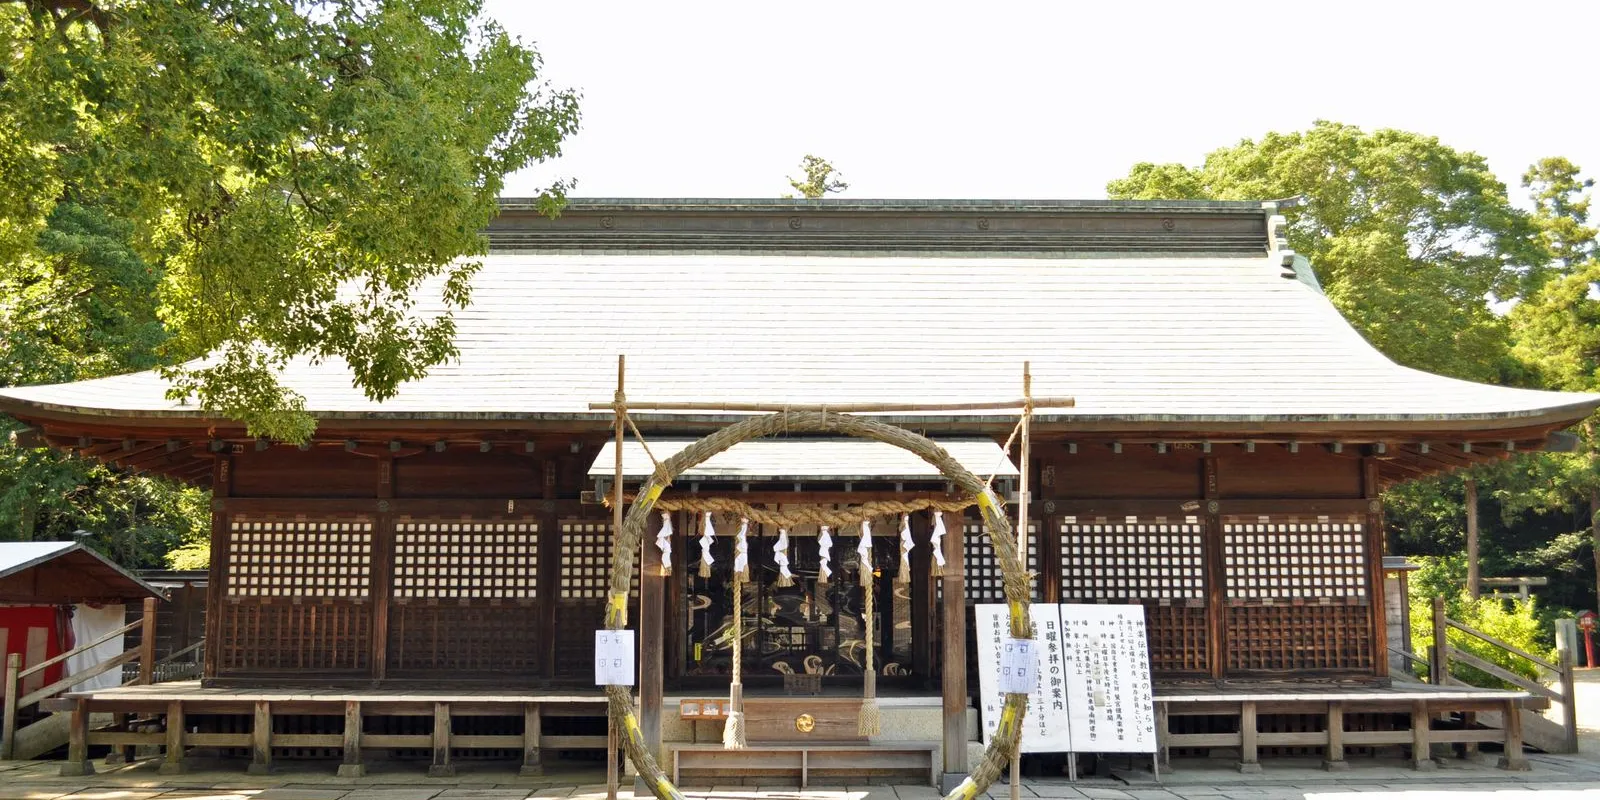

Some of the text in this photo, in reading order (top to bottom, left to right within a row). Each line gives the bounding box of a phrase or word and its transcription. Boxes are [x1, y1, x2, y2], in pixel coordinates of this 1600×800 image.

[1046, 620, 1063, 710] 日曜参拝の御案内
[1136, 619, 1153, 733] 神楽伝承教室のお知らせ
